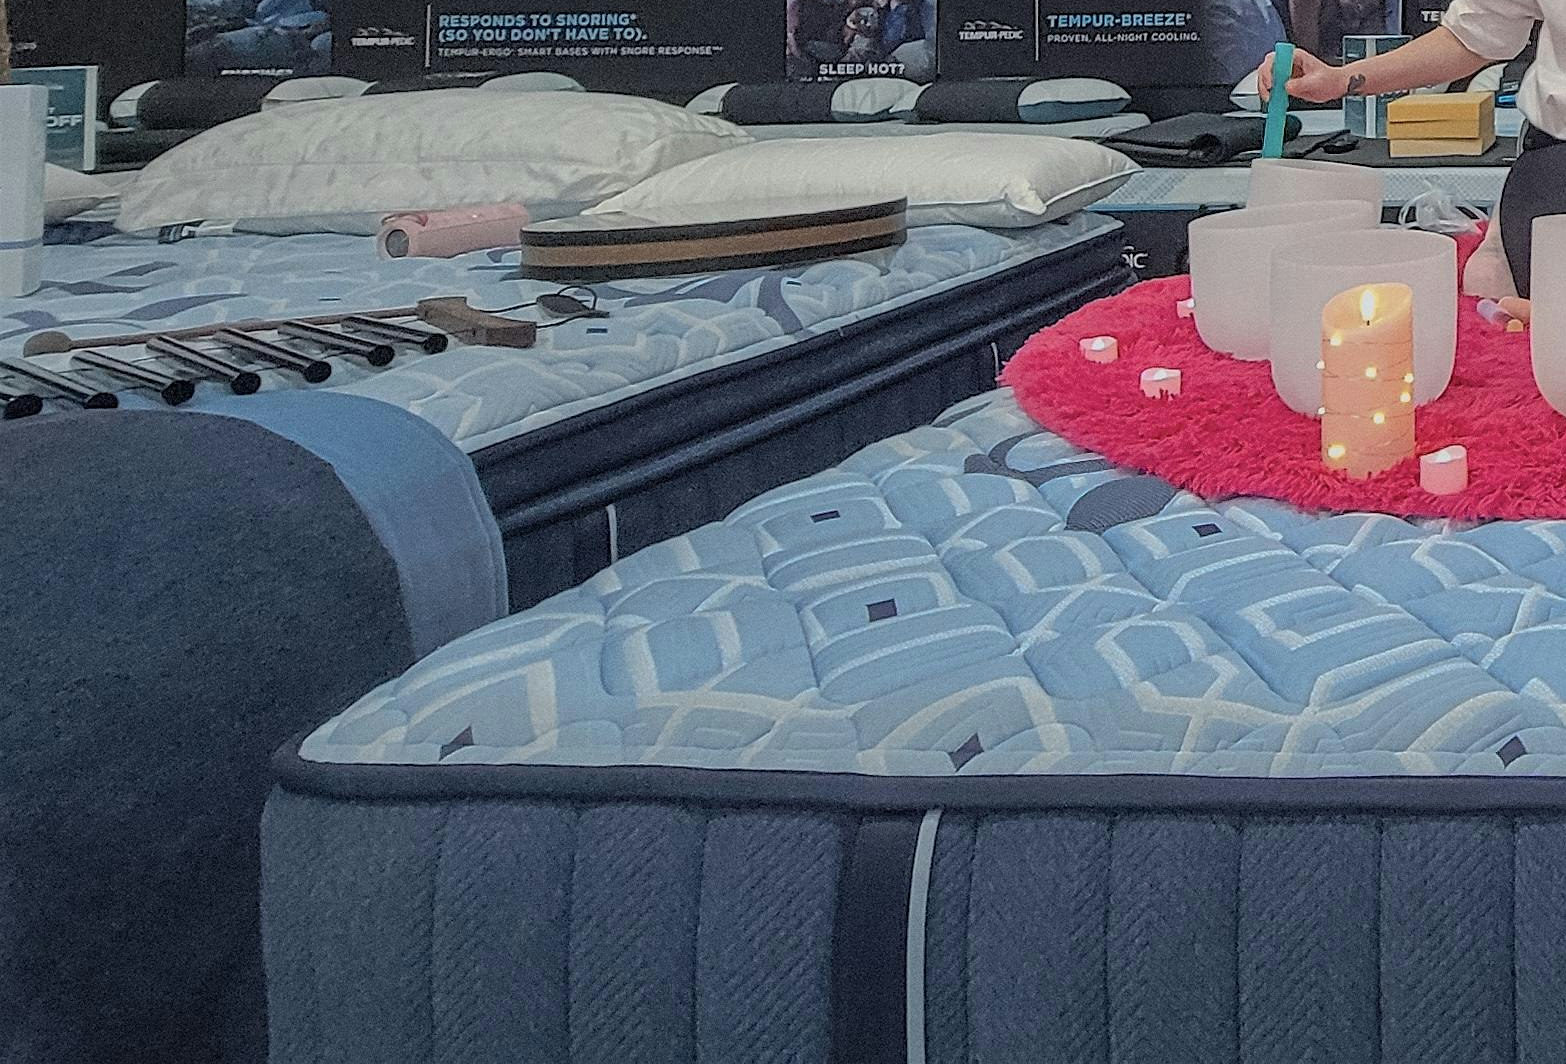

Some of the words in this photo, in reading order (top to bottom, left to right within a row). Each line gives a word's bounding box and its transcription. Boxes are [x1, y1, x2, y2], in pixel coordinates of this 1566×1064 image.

[438, 14, 526, 27] RESPONDS
[529, 14, 552, 27] TO
[438, 28, 468, 42] (SO
[473, 28, 507, 42] YOU
[510, 27, 562, 41] DON'T
[565, 27, 610, 41] HAVE
[613, 27, 648, 41] TO).
[1094, 32, 1148, 42] ALL-NIGHT
[517, 47, 553, 56] SMART
[555, 46, 588, 56] BASES
[591, 46, 618, 56] WITH
[620, 46, 655, 55] SNORE
[819, 63, 865, 75] SLEEP
[868, 62, 906, 75] HOT?
